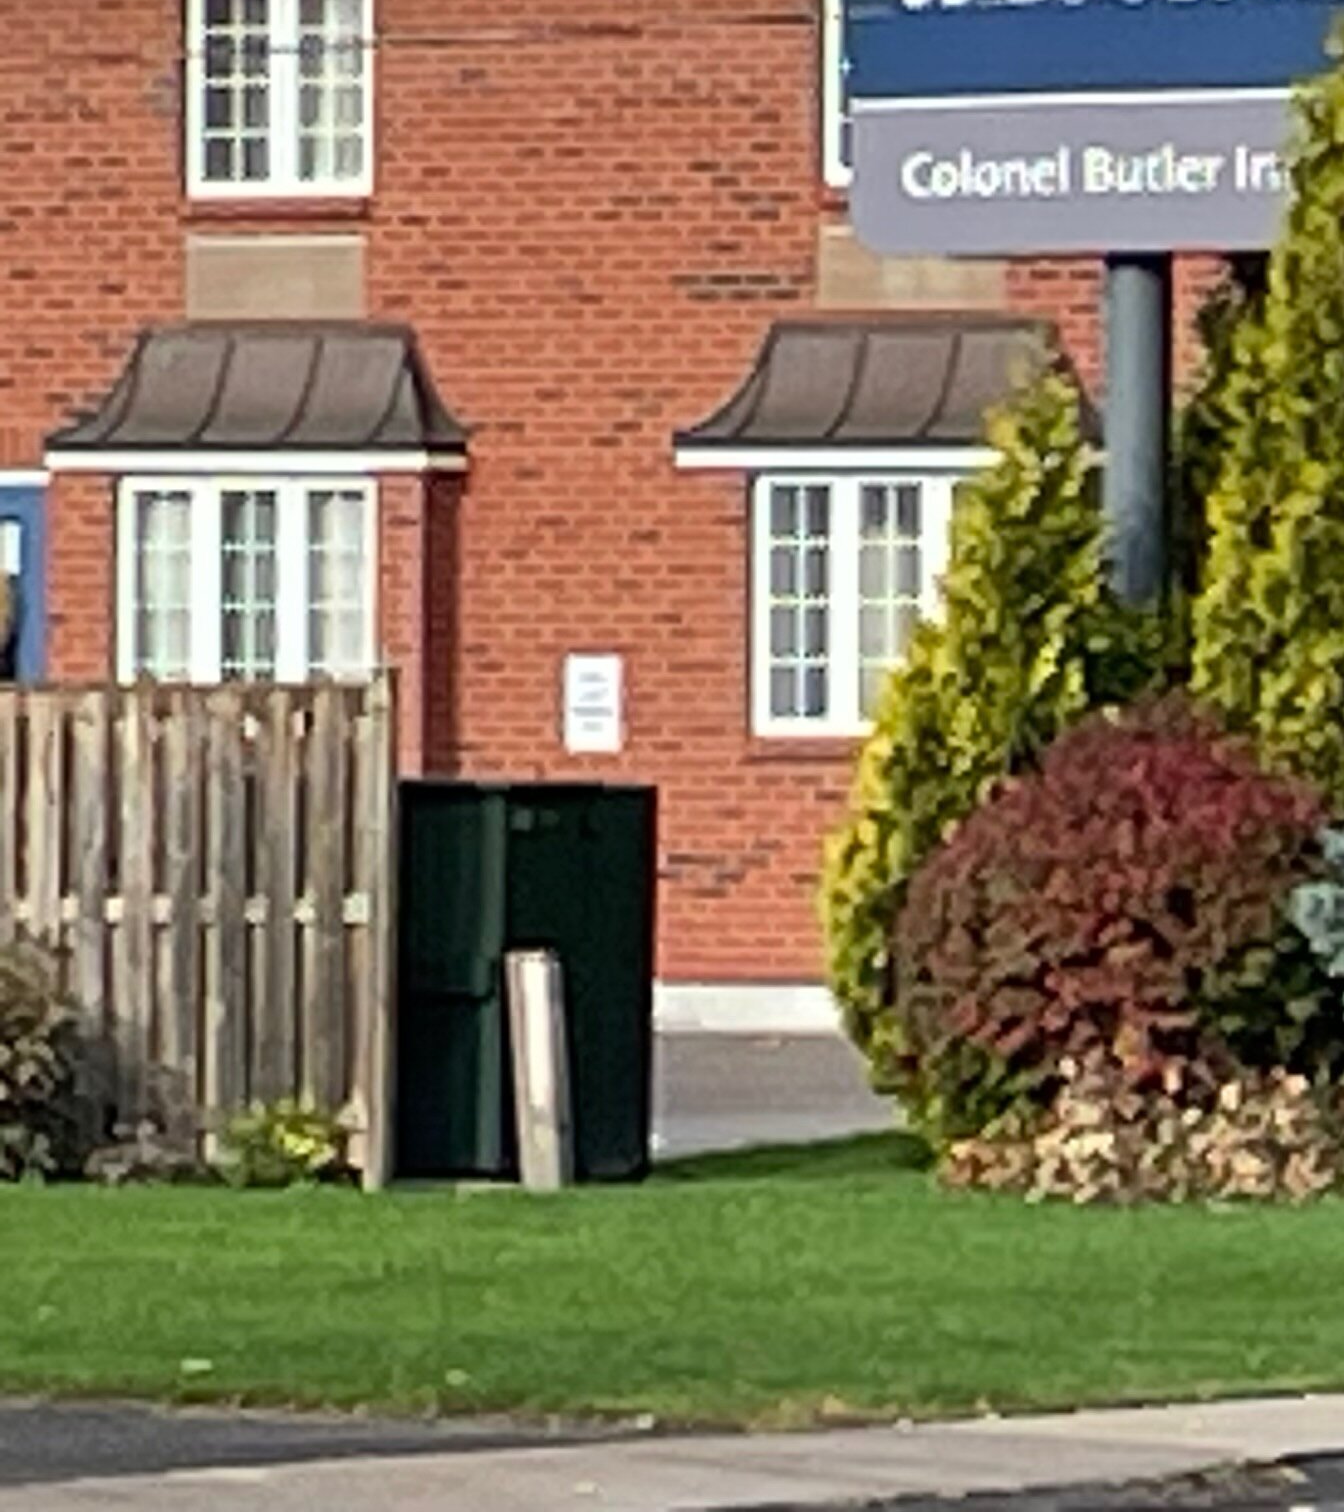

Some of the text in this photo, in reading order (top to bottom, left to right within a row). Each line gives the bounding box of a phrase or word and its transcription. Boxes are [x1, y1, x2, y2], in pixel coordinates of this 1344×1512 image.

[900, 141, 1291, 199] Colonel Butler In
